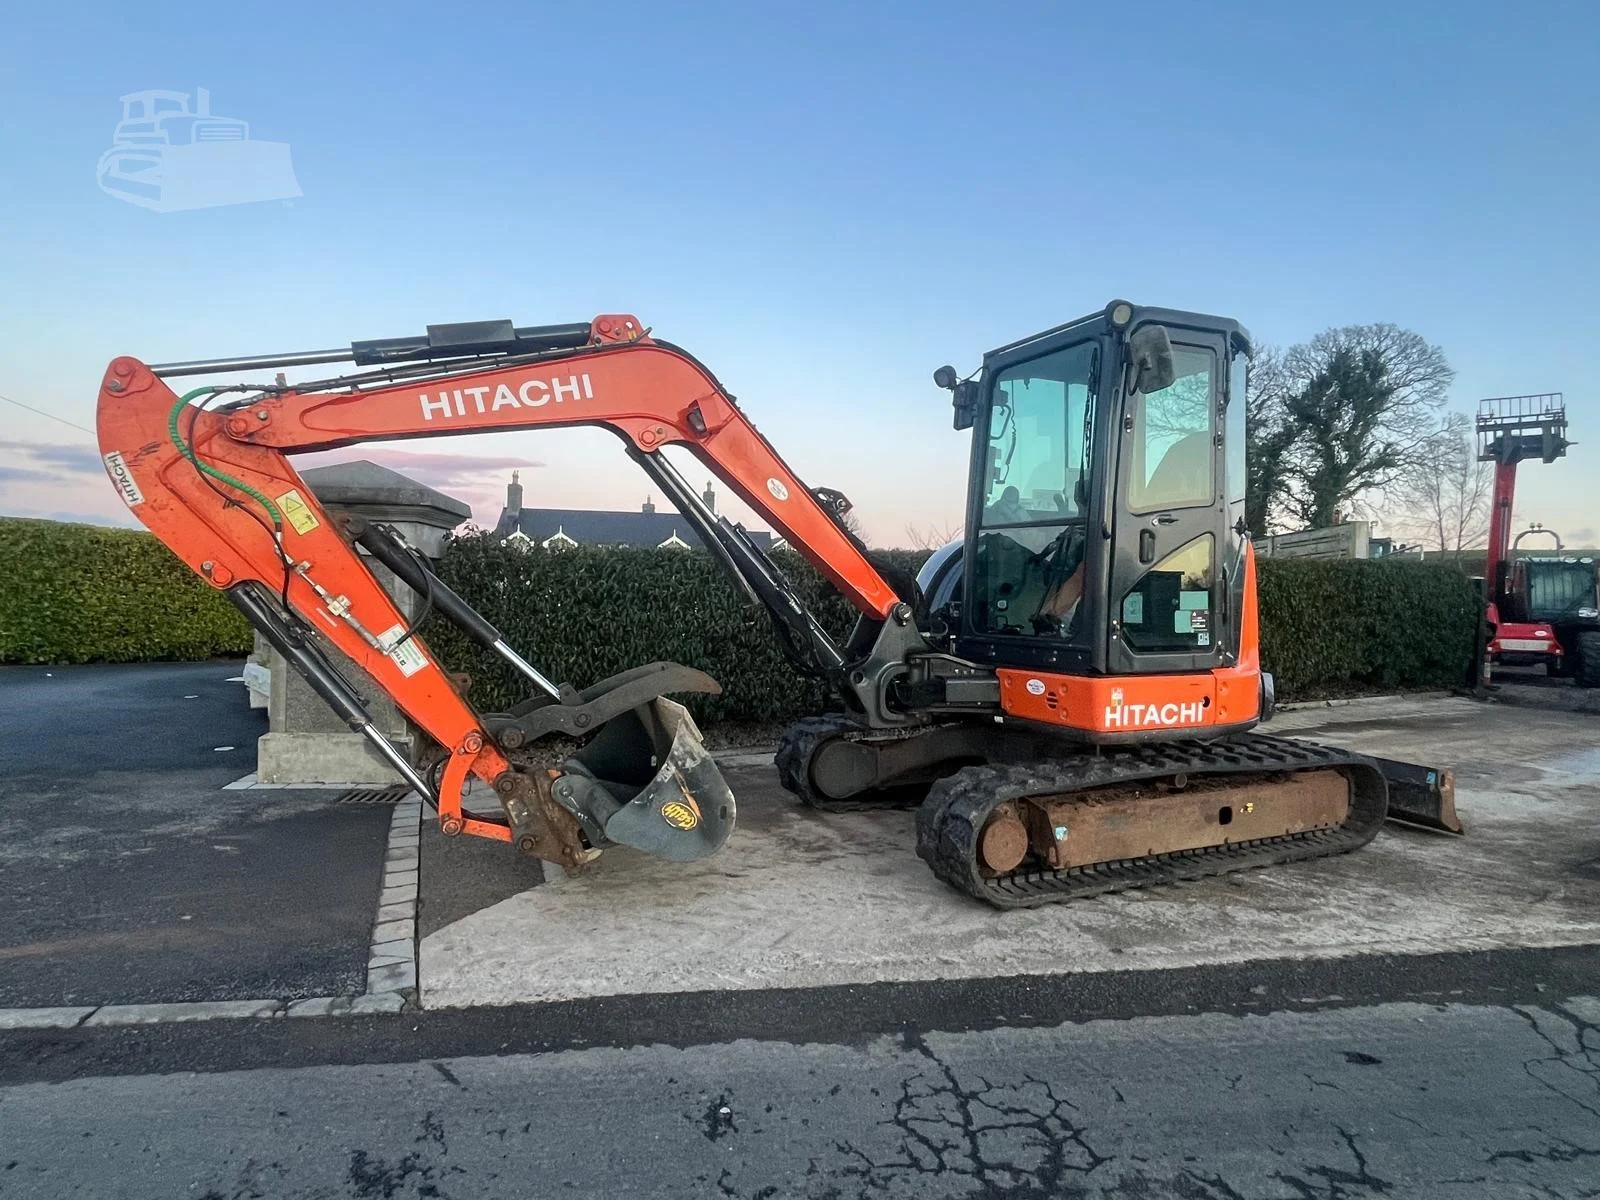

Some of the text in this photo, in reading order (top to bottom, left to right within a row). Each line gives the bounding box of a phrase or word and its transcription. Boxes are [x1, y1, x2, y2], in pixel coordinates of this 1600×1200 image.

[419, 374, 593, 420] HITACHI
[107, 454, 139, 502] HITACHI
[1105, 702, 1203, 728] HITACHI
